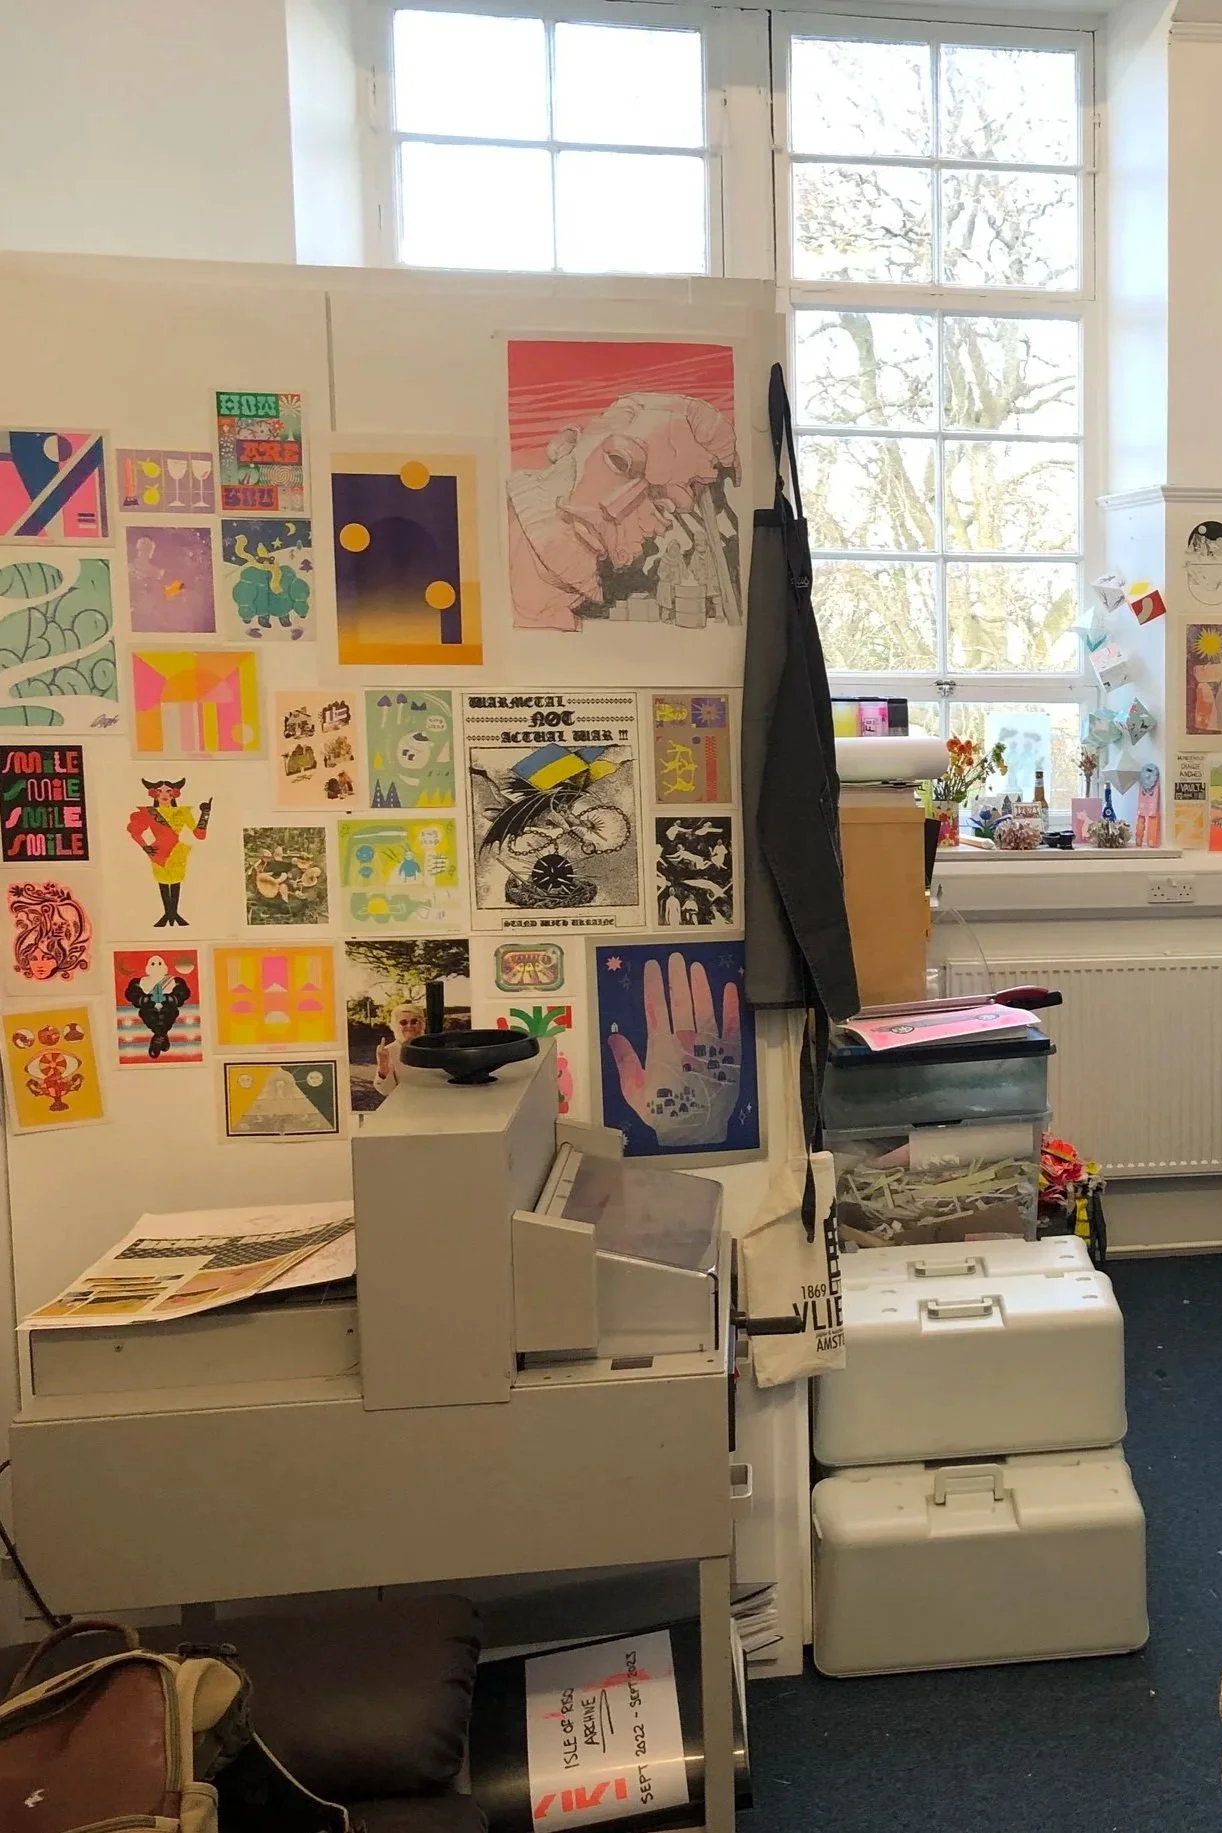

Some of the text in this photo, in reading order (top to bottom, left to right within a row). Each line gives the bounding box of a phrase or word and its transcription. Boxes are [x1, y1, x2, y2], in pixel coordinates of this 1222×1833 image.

[219, 394, 277, 416] HOW
[468, 696, 566, 709] WARMETAL
[500, 730, 567, 743] ACTUAL
[572, 729, 613, 742] WAR
[503, 918, 615, 928] STAND WITH UKRAINE
[801, 1284, 827, 1299] 1869
[625, 1650, 638, 1679] 2023
[627, 1681, 642, 1709] SEPT
[560, 1687, 580, 1769] ISLE OF RISO
[633, 1723, 647, 1757] 2022
[638, 1764, 654, 1805] SEPT
